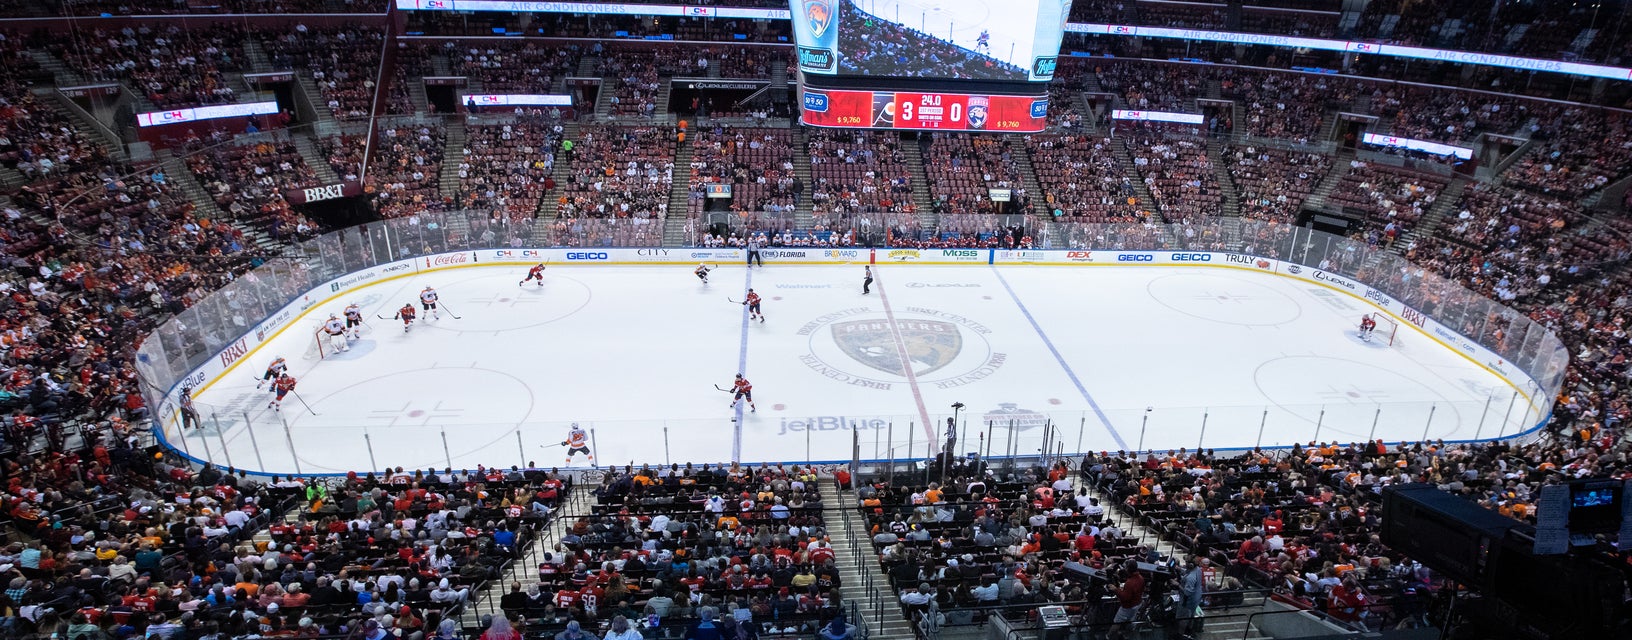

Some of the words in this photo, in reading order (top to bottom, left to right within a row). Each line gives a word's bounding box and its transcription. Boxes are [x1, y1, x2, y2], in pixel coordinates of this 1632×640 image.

[536, 3, 626, 13] CONDITIONERS
[767, 10, 786, 18] AIR
[1183, 30, 1202, 39] AIR
[1205, 32, 1289, 45] CONDITIONERS
[1434, 50, 1457, 60] AIR
[1461, 53, 1562, 71] CONDITIONERS
[921, 95, 941, 106] 24.0
[163, 111, 182, 120] CH
[902, 101, 913, 120] 3
[950, 103, 961, 122] 0
[842, 116, 861, 124] 9,760
[303, 184, 345, 203] BB&T
[566, 252, 608, 260] GEICO
[1118, 254, 1153, 262] GEICO
[1171, 253, 1211, 262] GEICO
[1225, 254, 1256, 264] TRULY
[340, 278, 357, 288] Baptist
[357, 272, 376, 282] Health
[1325, 275, 1355, 290] LEXUS
[1364, 287, 1390, 306] jetBlue
[1401, 306, 1427, 329] BB&T
[1435, 327, 1456, 342] Walmart
[220, 337, 248, 368] BB&T
[777, 416, 887, 435] jetBlue
